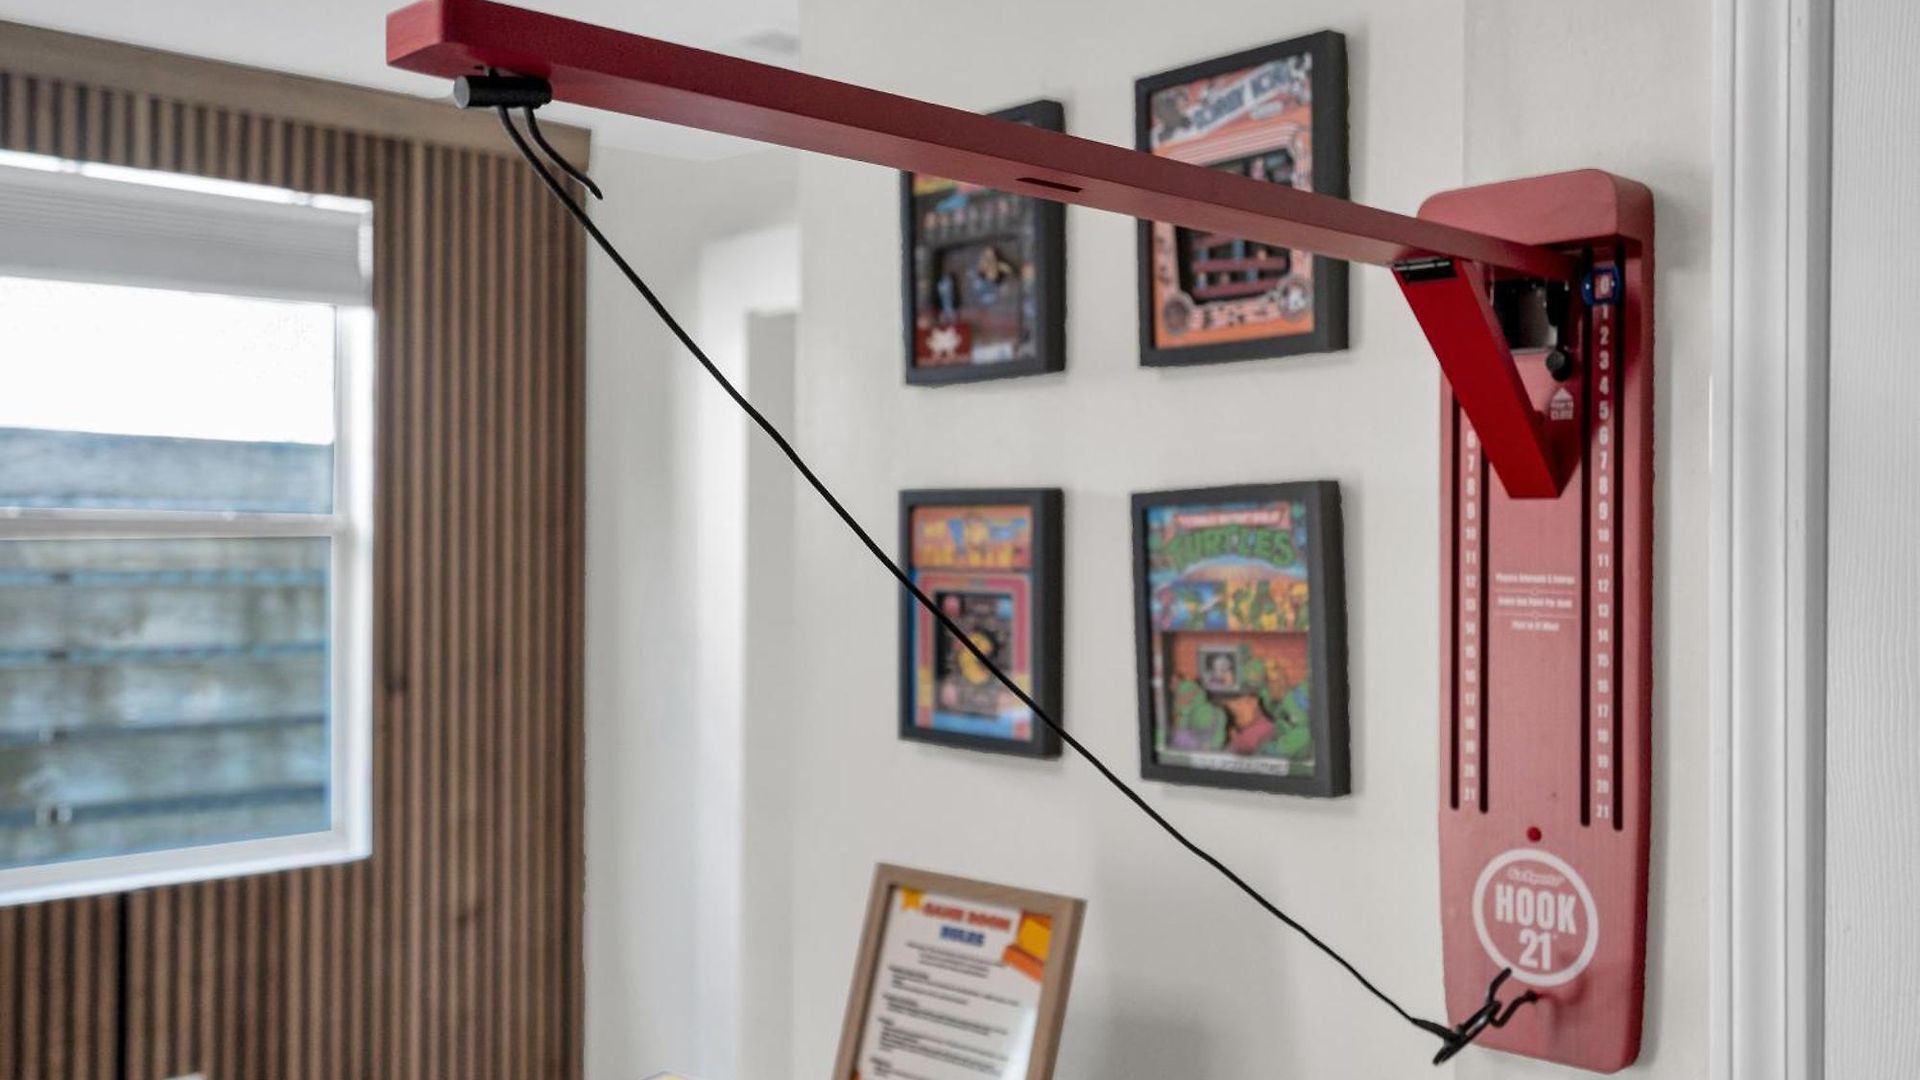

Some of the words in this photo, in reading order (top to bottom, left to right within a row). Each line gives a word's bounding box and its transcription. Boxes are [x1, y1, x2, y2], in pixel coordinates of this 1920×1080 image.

[1599, 275, 1610, 295] 0
[1600, 302, 1609, 320] 1
[1599, 325, 1610, 346] 2
[1599, 350, 1610, 371] 3
[1599, 375, 1610, 396] 4
[1598, 400, 1609, 420] 5
[1598, 425, 1609, 446] 6
[1467, 455, 1475, 471] 7
[1599, 450, 1608, 470] 7
[1598, 475, 1609, 495] 8
[1598, 500, 1609, 521] 9
[1465, 551, 1476, 564] 11
[1597, 553, 1609, 567] 11
[1597, 578, 1609, 593] 12
[1597, 704, 1609, 718] 17
[1495, 883, 1576, 934] HOOK
[1519, 928, 1551, 970] 21
